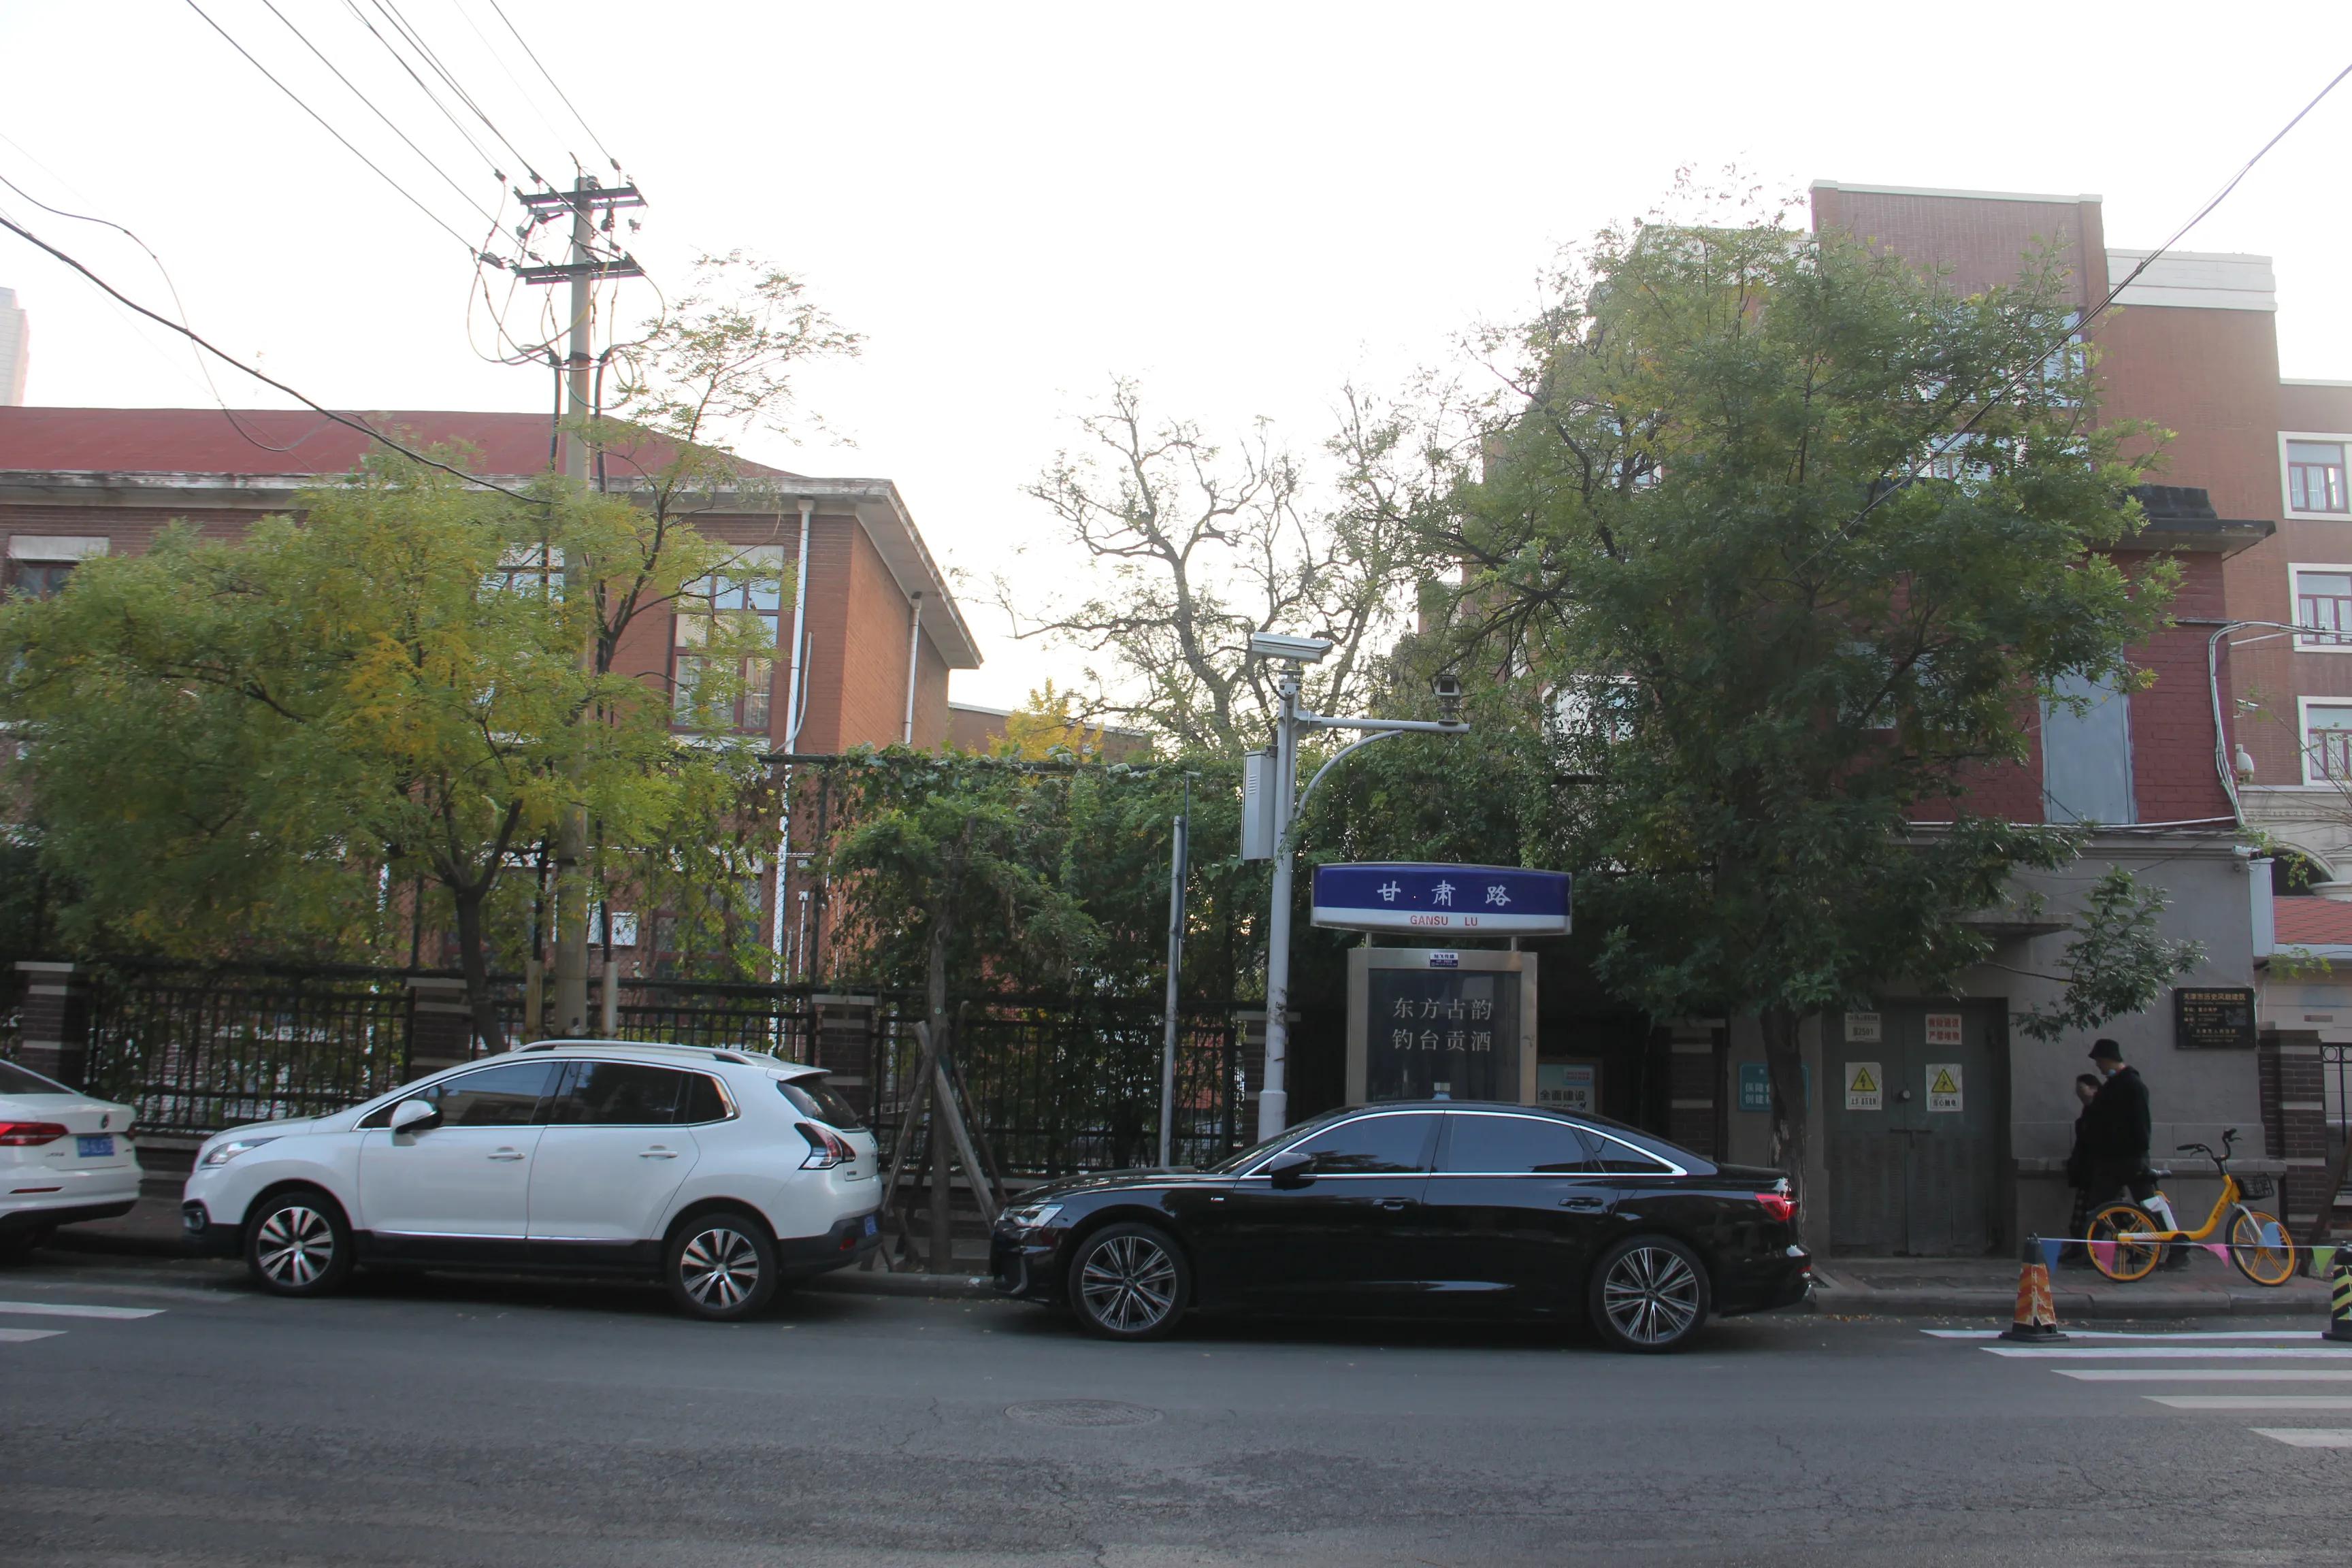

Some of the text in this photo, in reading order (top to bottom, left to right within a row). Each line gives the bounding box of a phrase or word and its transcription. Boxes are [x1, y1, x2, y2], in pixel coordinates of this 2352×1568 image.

[1377, 880, 1512, 906] 甘肃路
[1410, 915, 1478, 926] GANSU LU
[1392, 998, 1492, 1021] 东方古韵
[1392, 1029, 1491, 1051] 钓台贡酒
[1539, 1090, 1585, 1101] 全面建设
